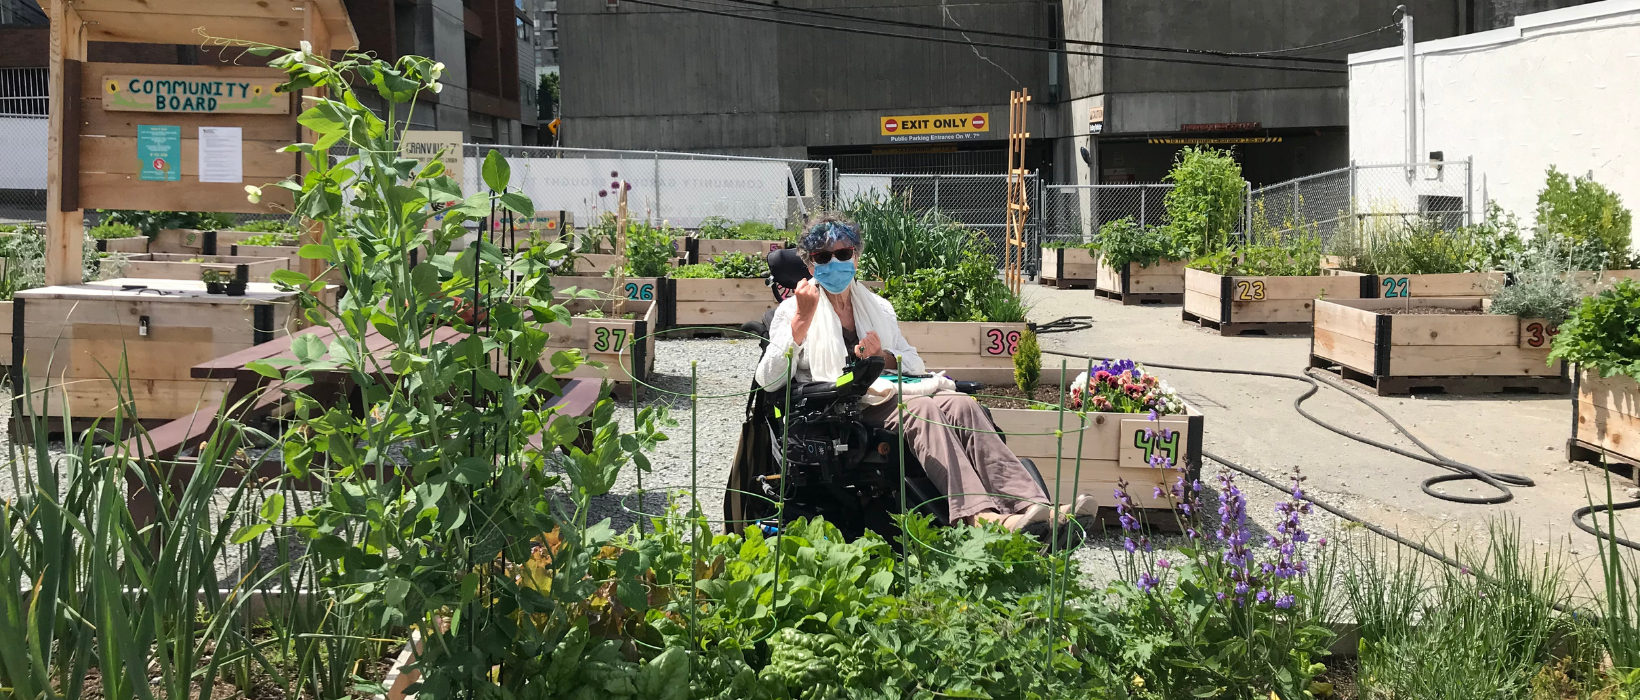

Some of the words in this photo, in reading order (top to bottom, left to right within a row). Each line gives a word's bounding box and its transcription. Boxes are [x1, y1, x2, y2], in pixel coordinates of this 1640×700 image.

[129, 79, 249, 98] COMMUNITY
[156, 96, 217, 111] BOARD
[901, 120, 929, 129] EXIT
[933, 118, 967, 128] ONLY
[908, 134, 930, 142] Parking
[930, 133, 954, 141] Entrance
[955, 132, 964, 140] On
[186, 232, 197, 246] 9
[624, 282, 654, 301] 26
[1237, 280, 1266, 300] 23
[1382, 277, 1410, 298] 22
[594, 327, 627, 352] 37
[987, 328, 1022, 356] 38
[1134, 429, 1181, 467] 44
